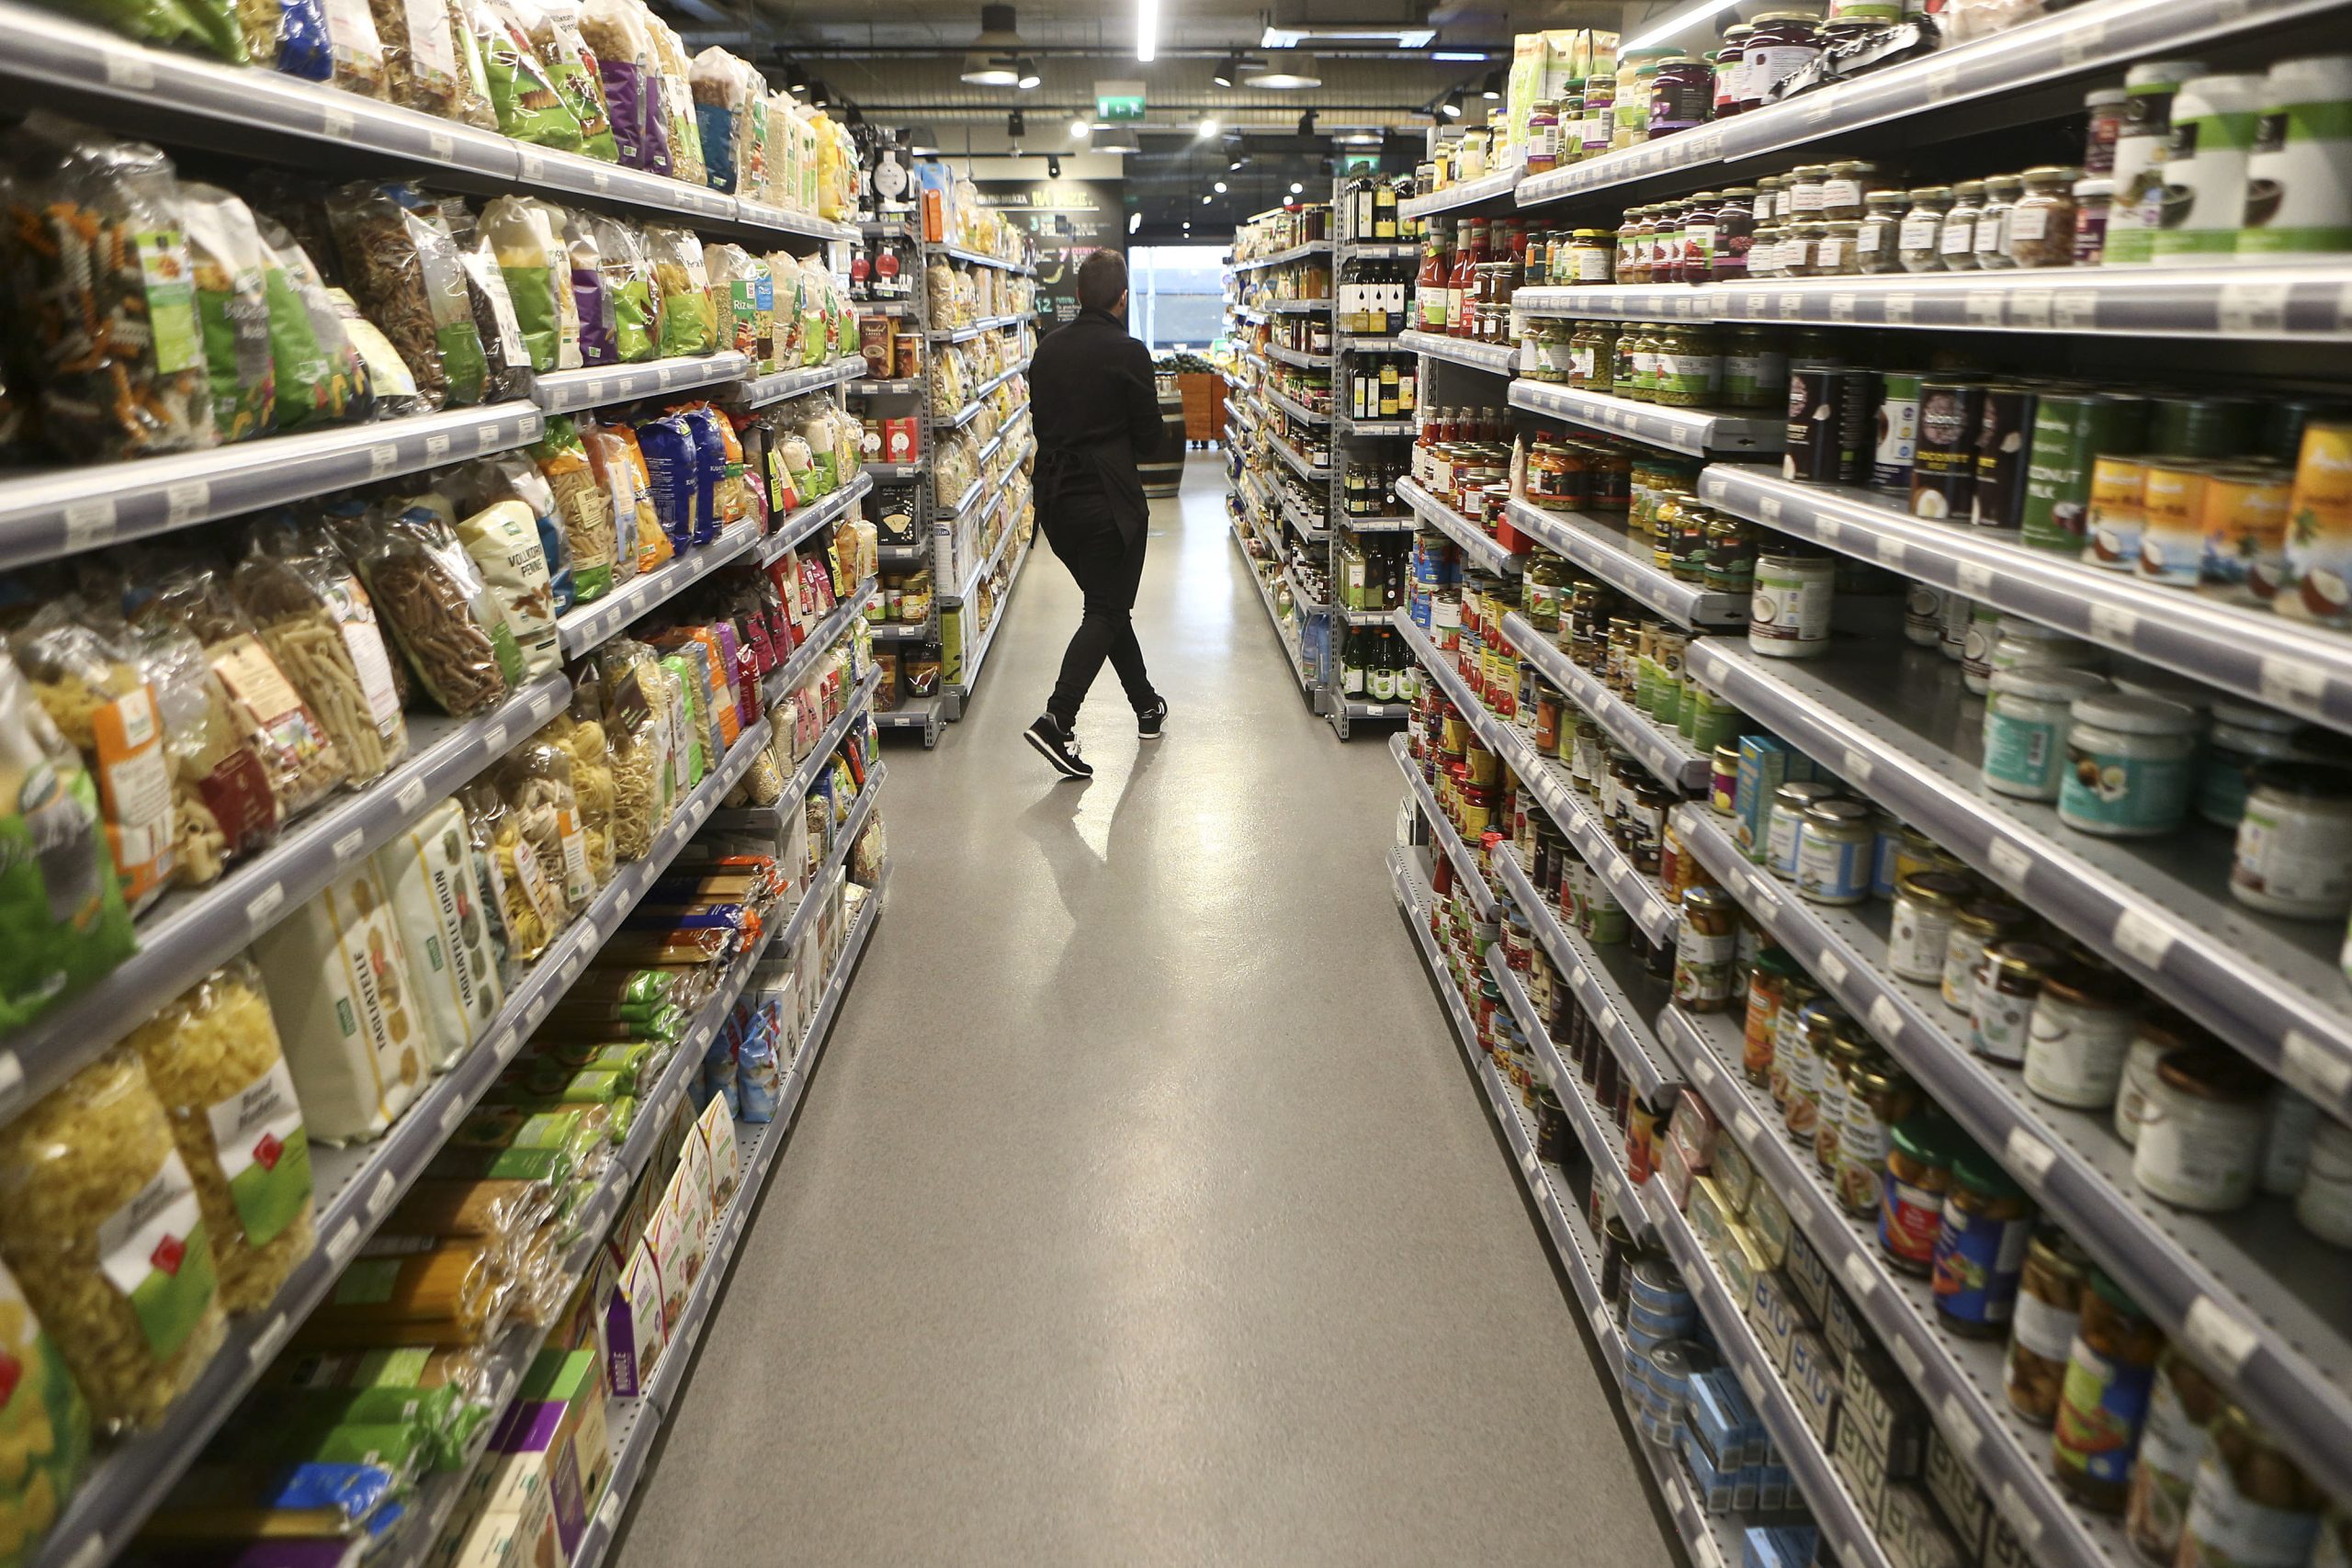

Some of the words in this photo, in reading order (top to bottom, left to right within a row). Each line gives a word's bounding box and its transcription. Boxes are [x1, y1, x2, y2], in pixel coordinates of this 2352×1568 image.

[733, 299, 747, 310] Riz
[1035, 297, 1053, 313] 12
[521, 558, 544, 578] PENNE
[447, 919, 474, 1009] TAGLIATELLE
[353, 948, 387, 1052] TAGLIATELLE
